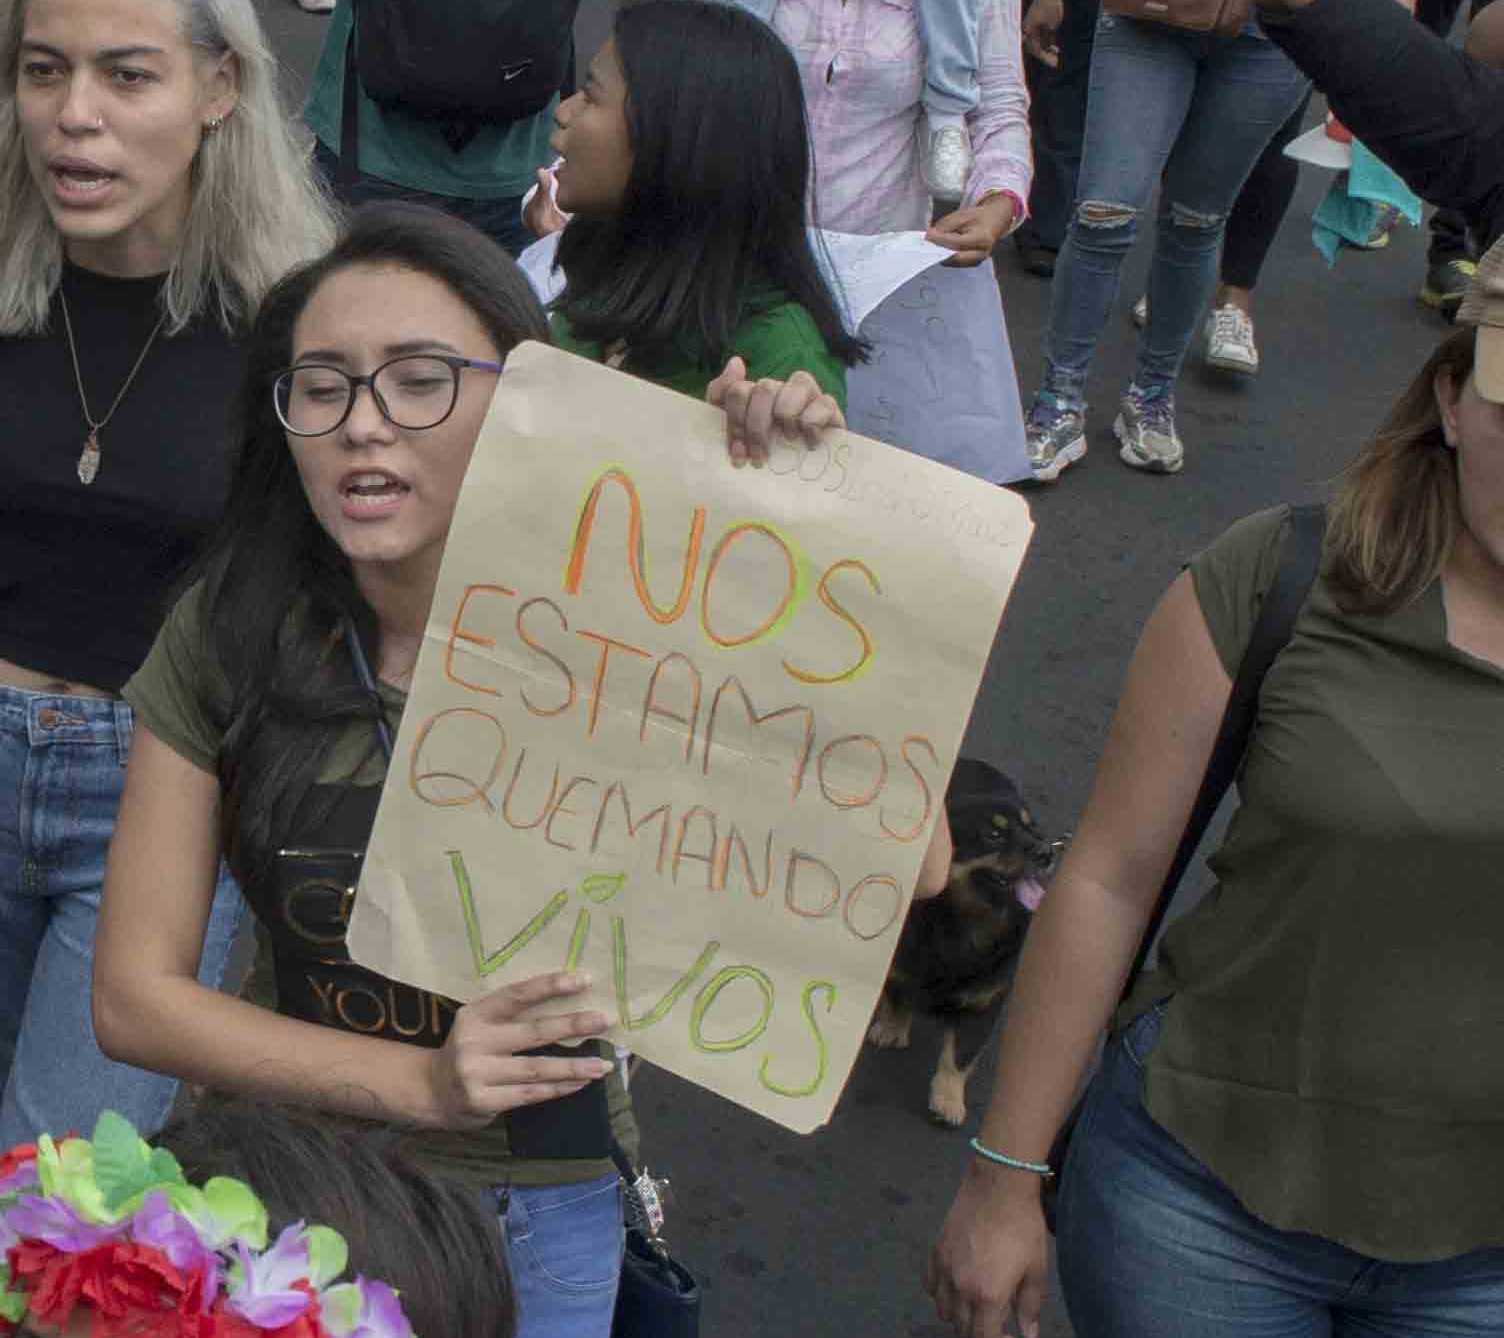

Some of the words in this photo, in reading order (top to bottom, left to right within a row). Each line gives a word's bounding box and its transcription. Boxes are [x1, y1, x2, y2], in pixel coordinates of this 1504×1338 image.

[562, 462, 885, 685] NOS
[409, 706, 904, 941] QUEMANDO
[442, 581, 940, 845] ESTAMOS
